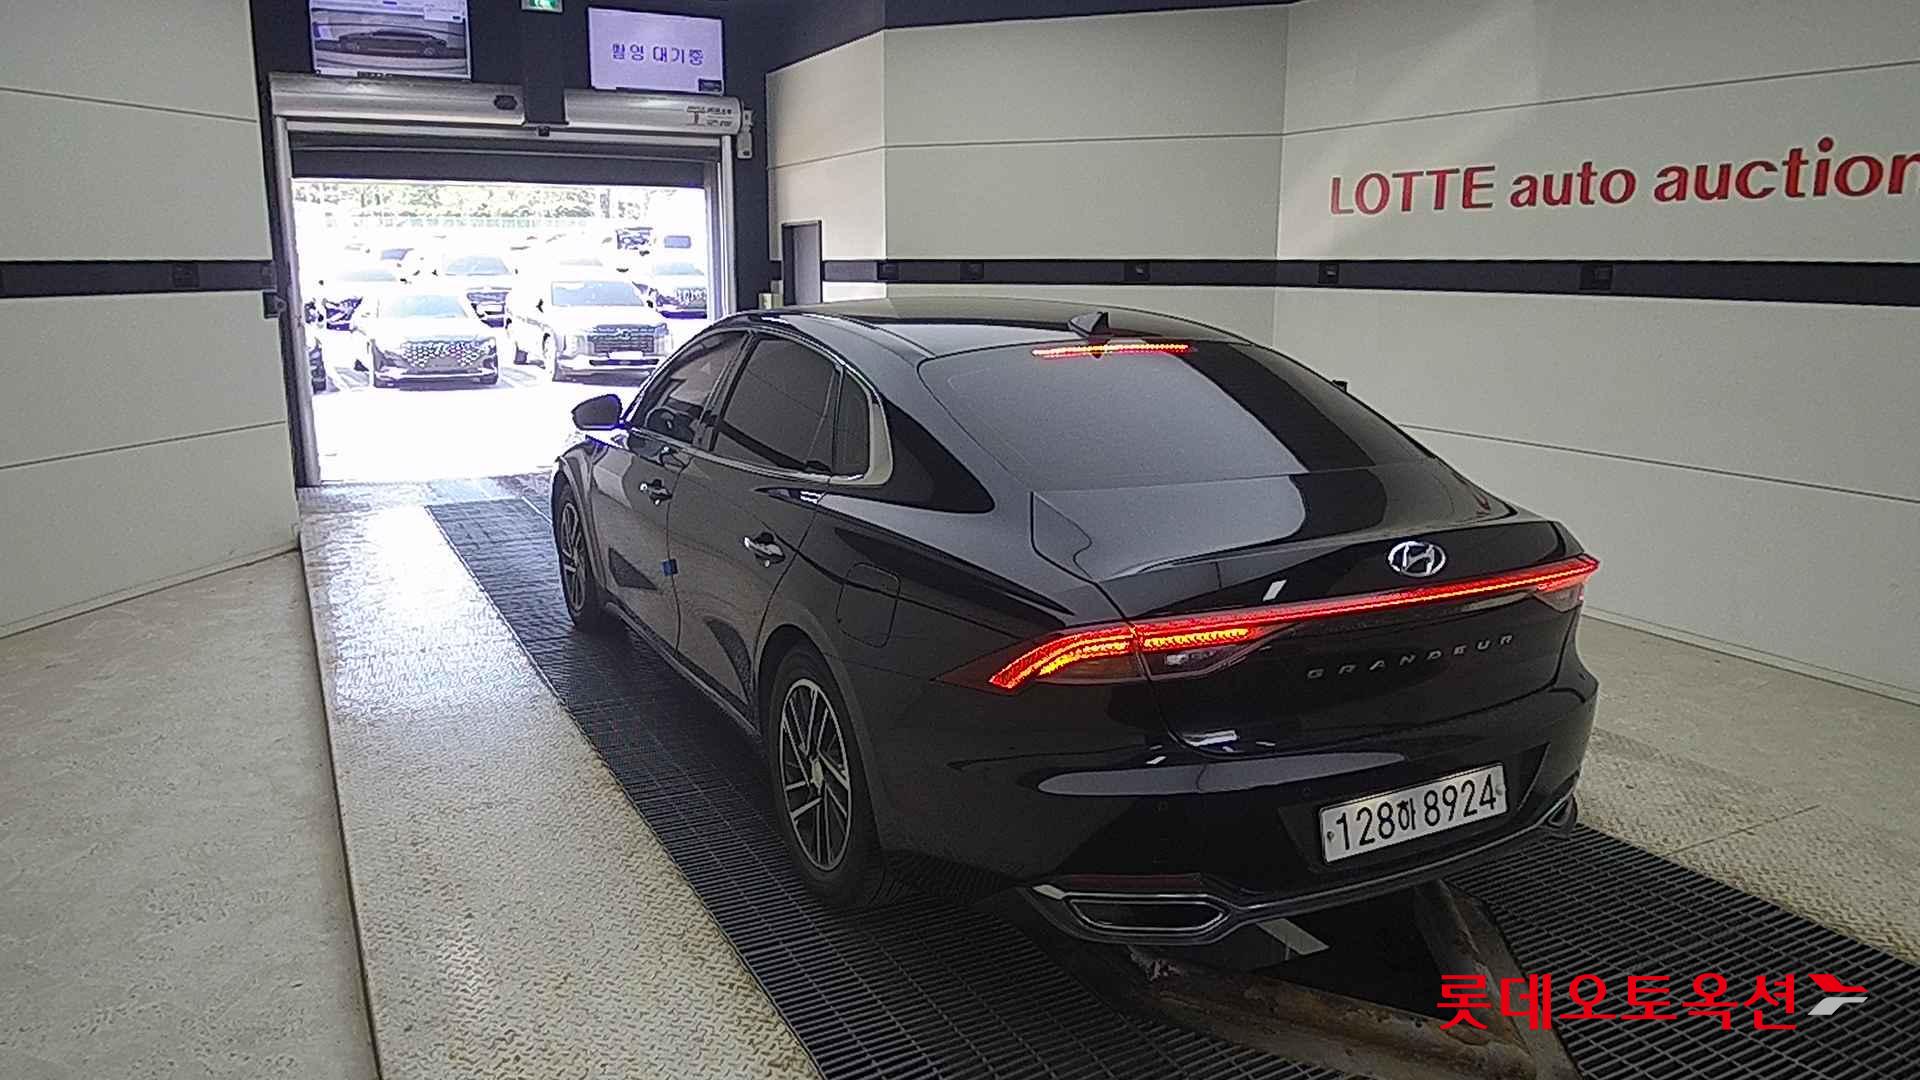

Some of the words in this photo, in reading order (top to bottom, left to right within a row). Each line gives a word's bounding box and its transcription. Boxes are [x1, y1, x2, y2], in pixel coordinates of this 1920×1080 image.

[652, 46, 704, 66] 대기중
[1330, 166, 1496, 215] LOTTE
[1510, 161, 1636, 208] auto
[1307, 634, 1513, 680] GRANDEUR
[1423, 774, 1497, 827] 8924
